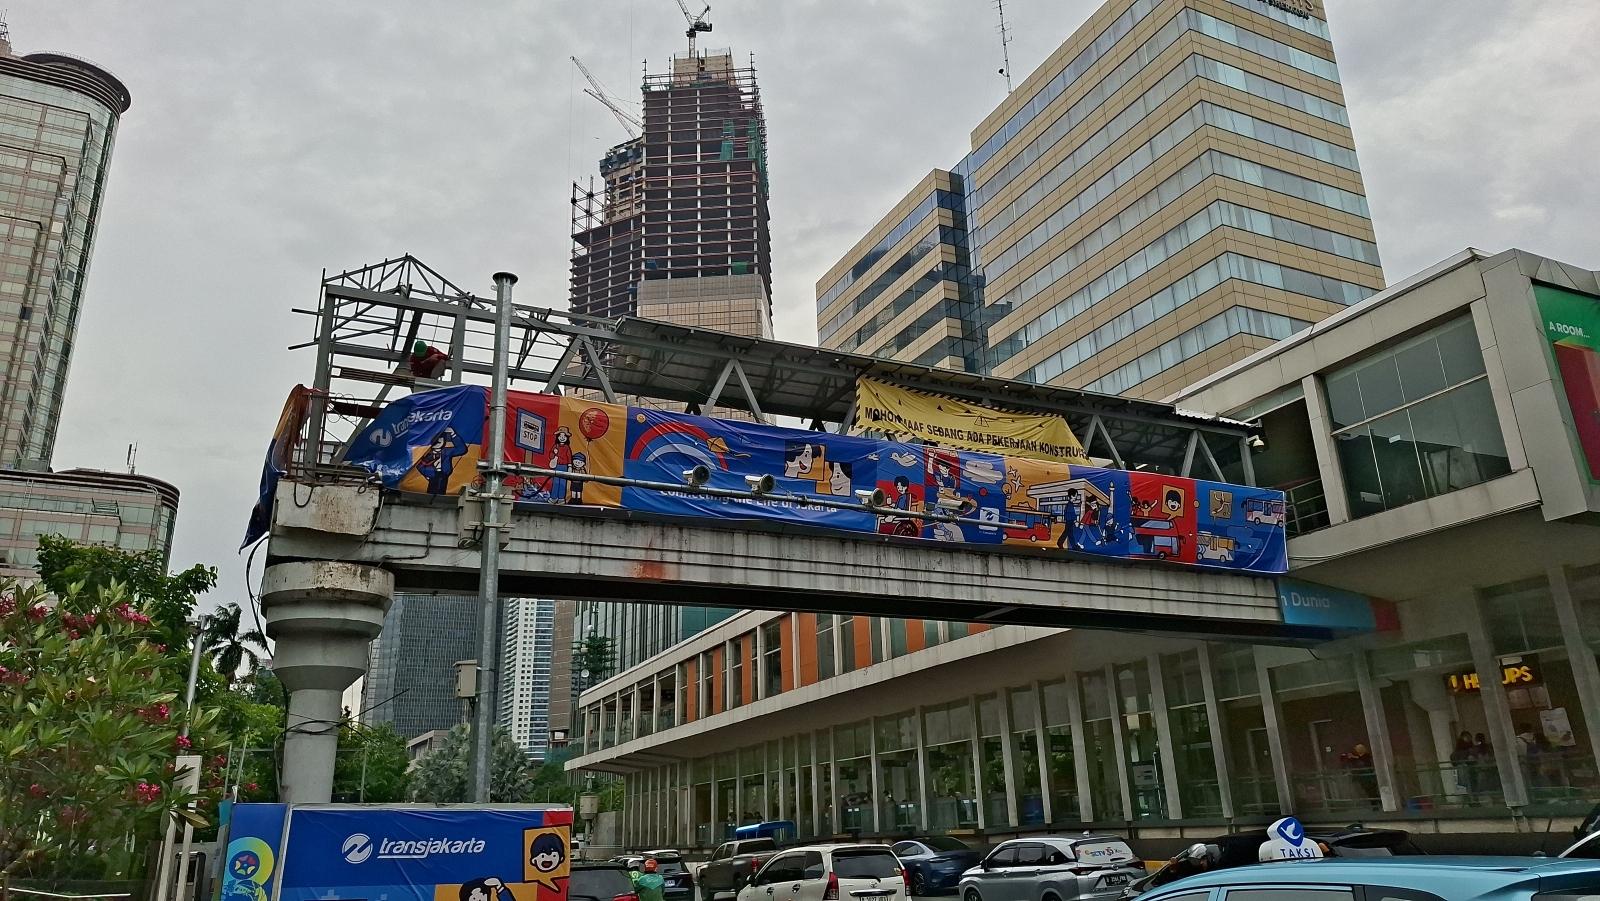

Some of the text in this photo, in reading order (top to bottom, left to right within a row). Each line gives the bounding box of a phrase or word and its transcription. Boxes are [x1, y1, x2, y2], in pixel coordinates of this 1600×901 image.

[1549, 321, 1556, 331] A
[522, 430, 538, 442] STOP
[1290, 591, 1330, 608] Dunia
[378, 837, 486, 859] transjakarta
[1280, 848, 1315, 859] TAKSI
